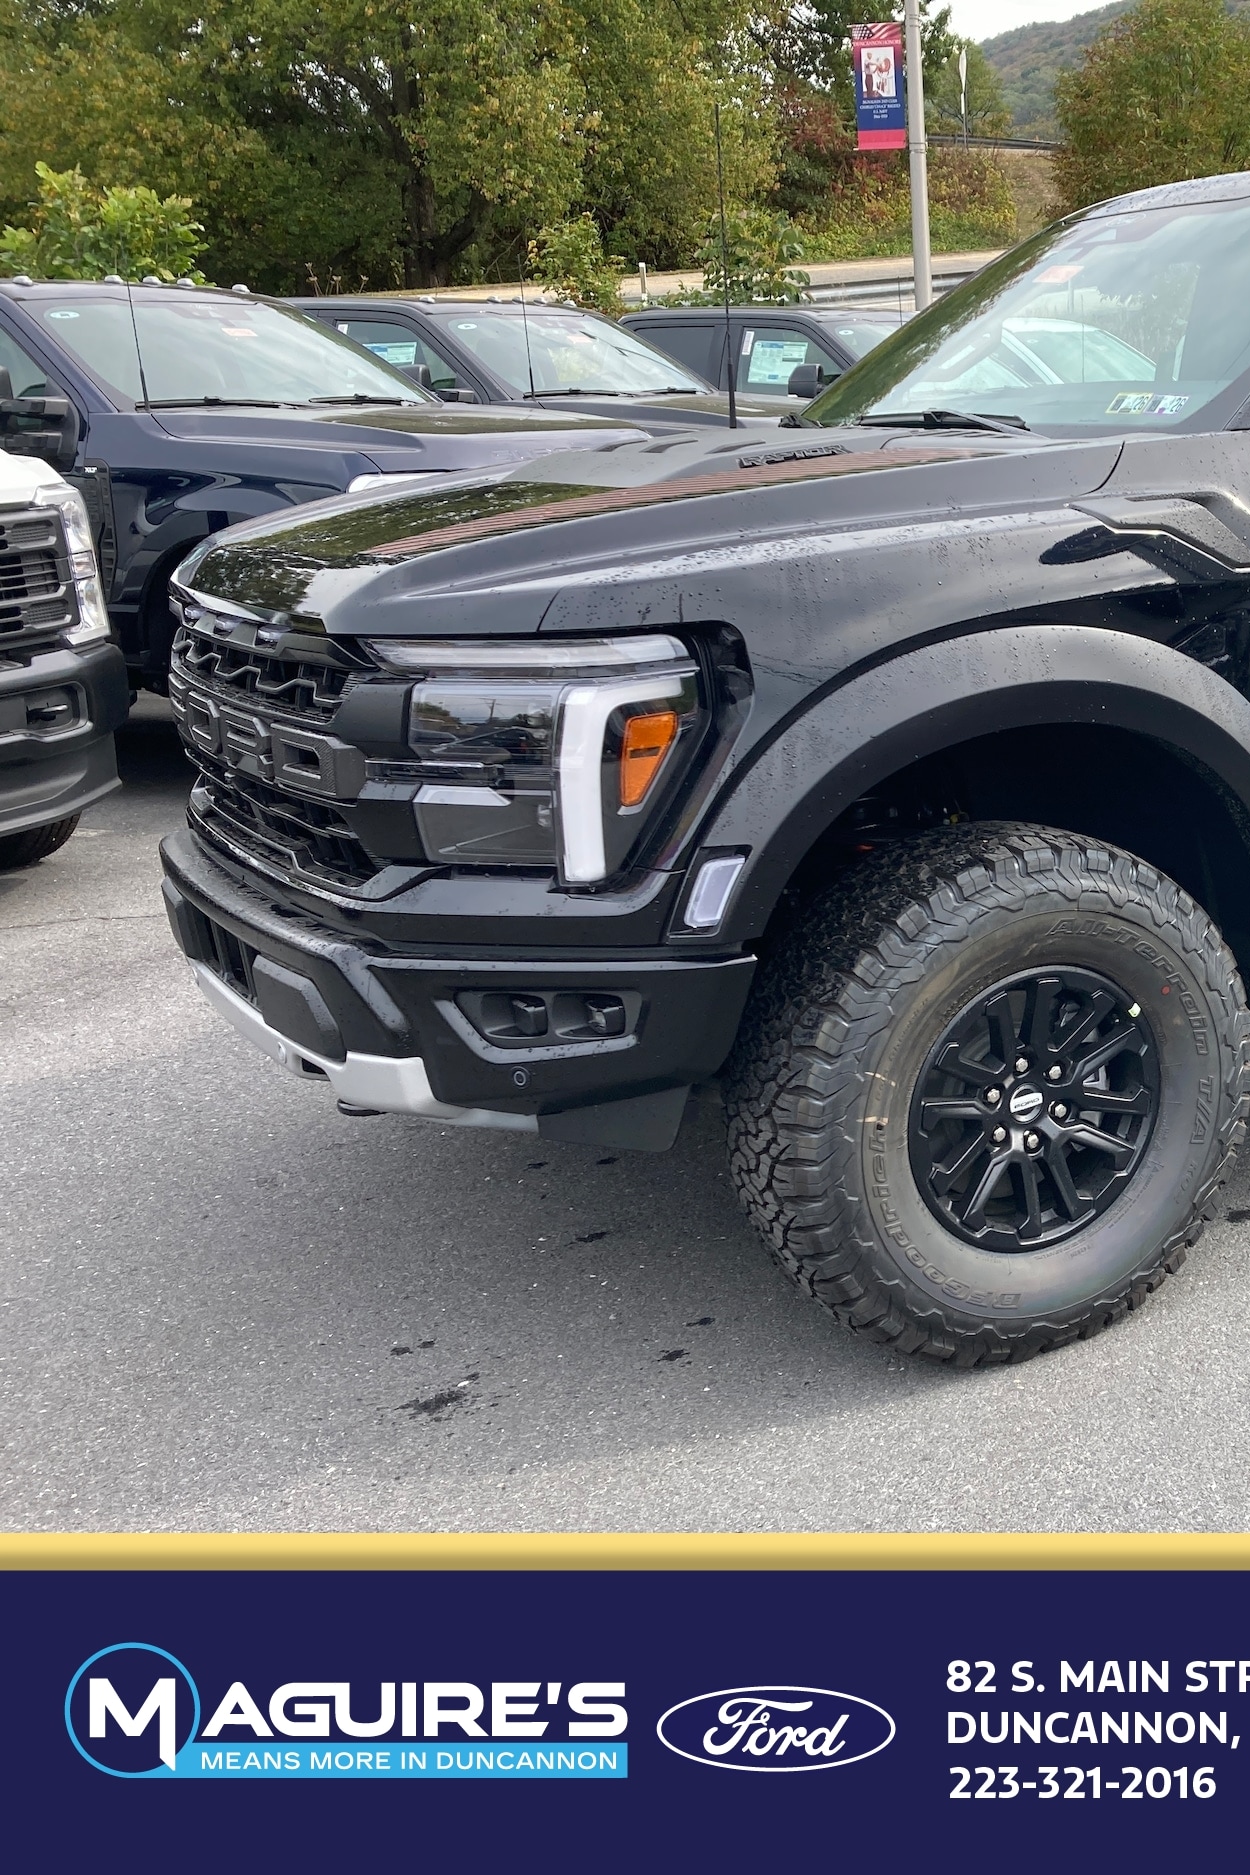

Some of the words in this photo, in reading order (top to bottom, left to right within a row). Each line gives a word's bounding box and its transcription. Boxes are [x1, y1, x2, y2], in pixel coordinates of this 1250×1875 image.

[735, 444, 853, 469] RAPTOR
[168, 672, 358, 803] FORD
[1013, 1097, 1040, 1109] FORD
